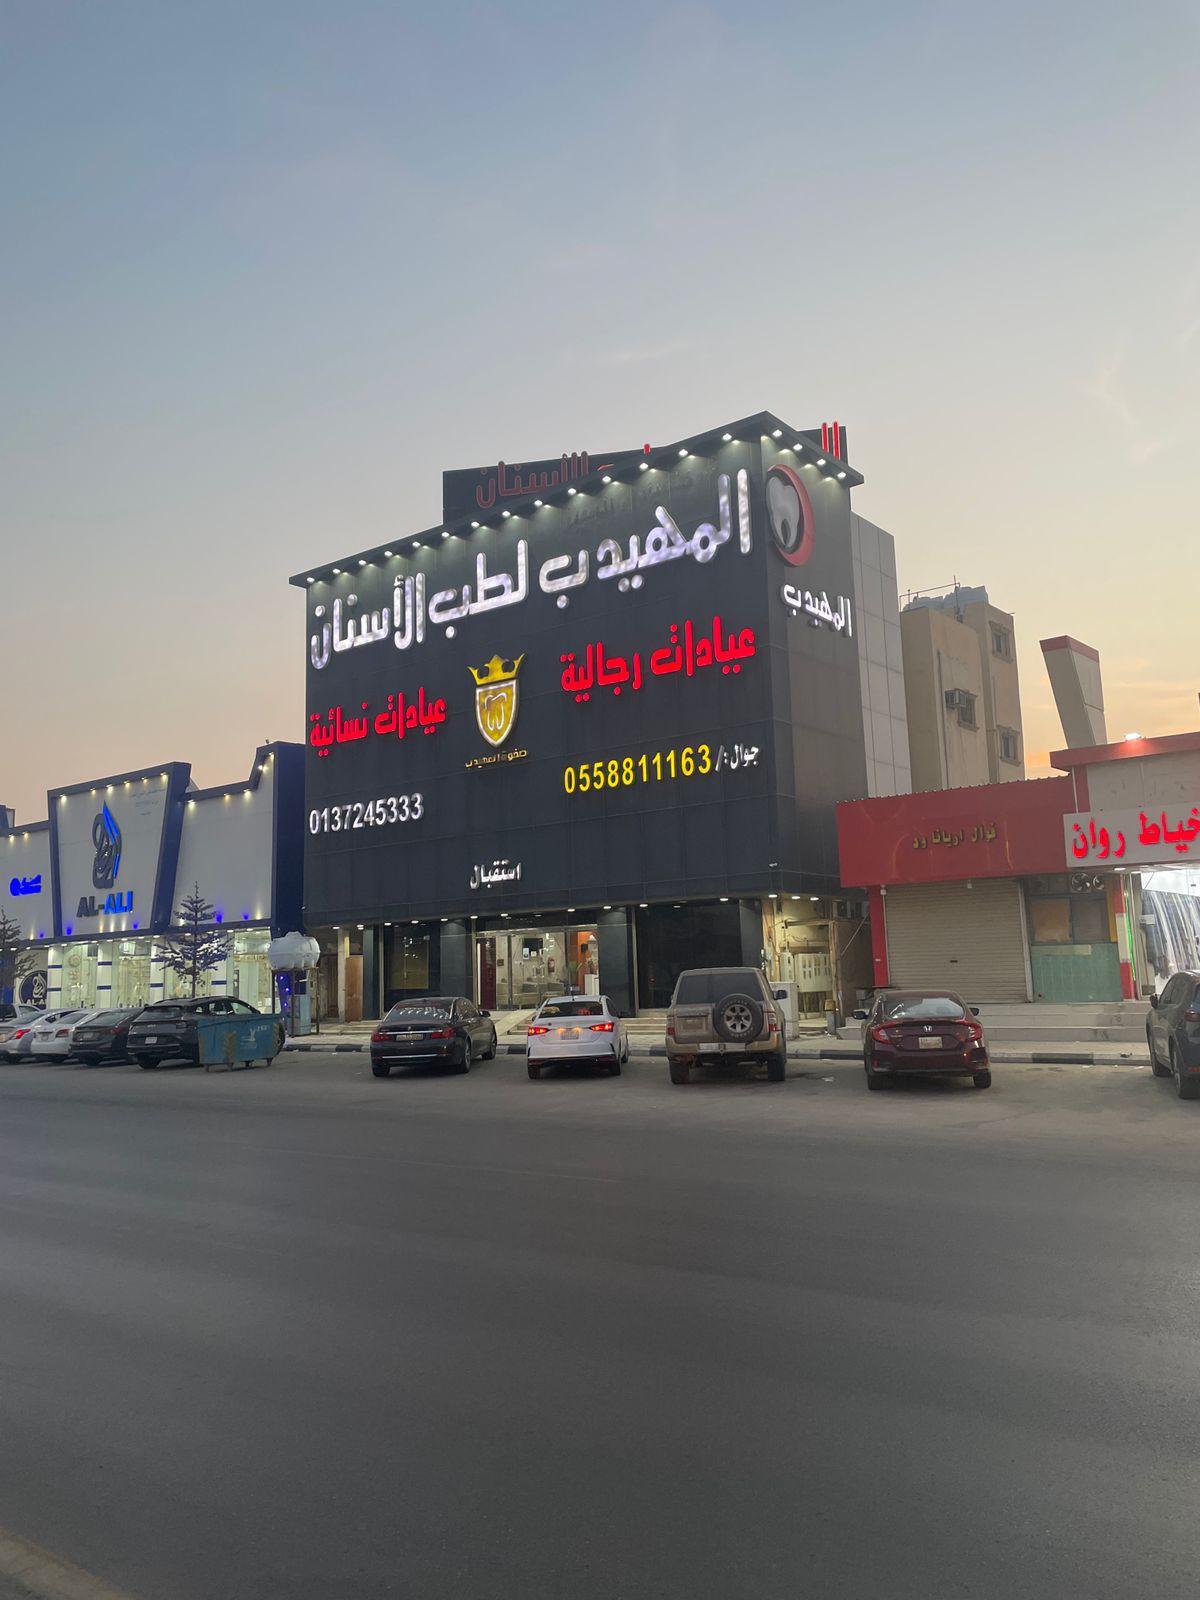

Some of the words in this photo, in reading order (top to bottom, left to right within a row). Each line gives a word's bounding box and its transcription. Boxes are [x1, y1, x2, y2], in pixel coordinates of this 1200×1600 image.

[539, 467, 752, 609] المهيدب
[428, 539, 528, 639] لطب
[780, 583, 852, 638] المهيدب
[310, 570, 427, 670] الأسنان
[650, 614, 756, 678] عيادات
[560, 640, 642, 704] رجالية
[309, 702, 369, 758] نسائية
[375, 686, 447, 739] عيادات
[564, 744, 711, 794] 0558811163
[309, 792, 424, 836] 0137245333
[1072, 817, 1126, 859] روان
[470, 859, 522, 890] استقبال
[76, 890, 134, 918] AL-ALI
